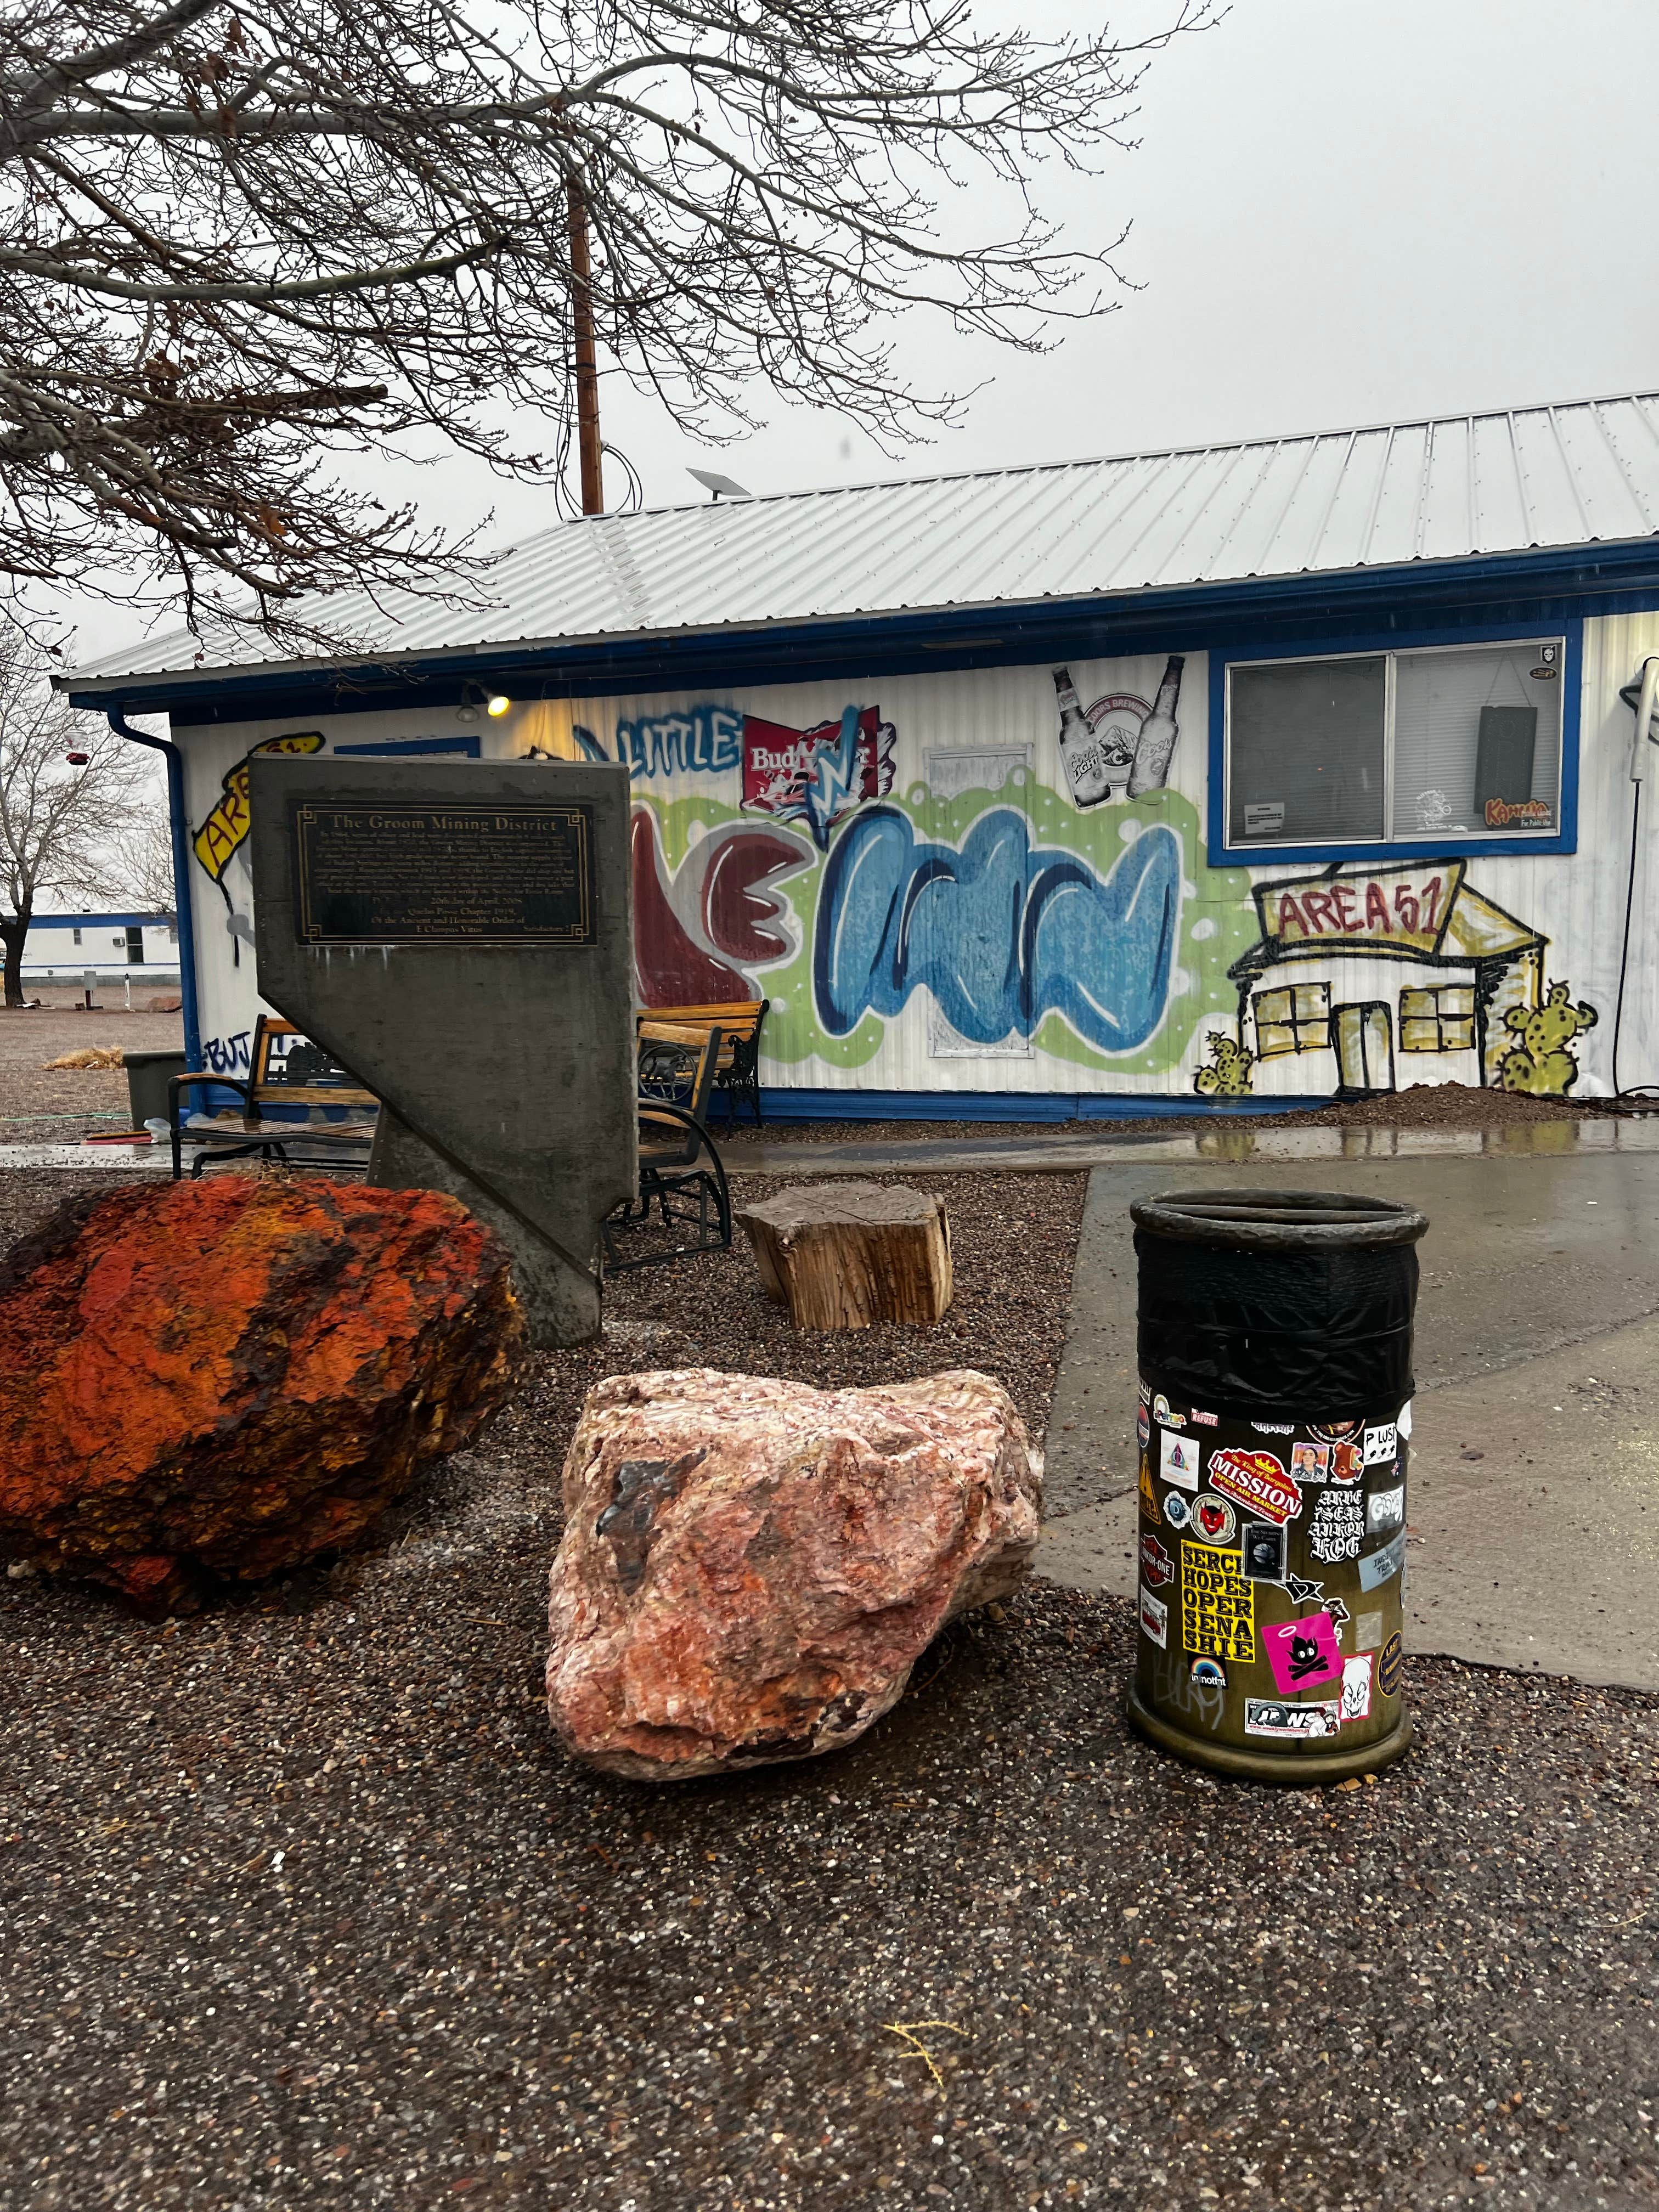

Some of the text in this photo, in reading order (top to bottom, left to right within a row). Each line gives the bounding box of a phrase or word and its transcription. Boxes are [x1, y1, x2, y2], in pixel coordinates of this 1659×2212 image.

[1088, 698, 1149, 723] COORS BREWING
[619, 707, 739, 775] LITTLE
[330, 815, 557, 833] The Groom Mining District
[1192, 1413, 1216, 1425] REFUSE
[1212, 1455, 1301, 1513] MISSION
[1231, 1454, 1293, 1492] The King of Bargains
[1215, 1472, 1288, 1517] OPEN AIR MARKET
[1183, 1566, 1252, 1598] HOPES
[1183, 1587, 1252, 1618] OPER
[1184, 1609, 1252, 1640] SENA
[1185, 1629, 1254, 1661] SHIE
